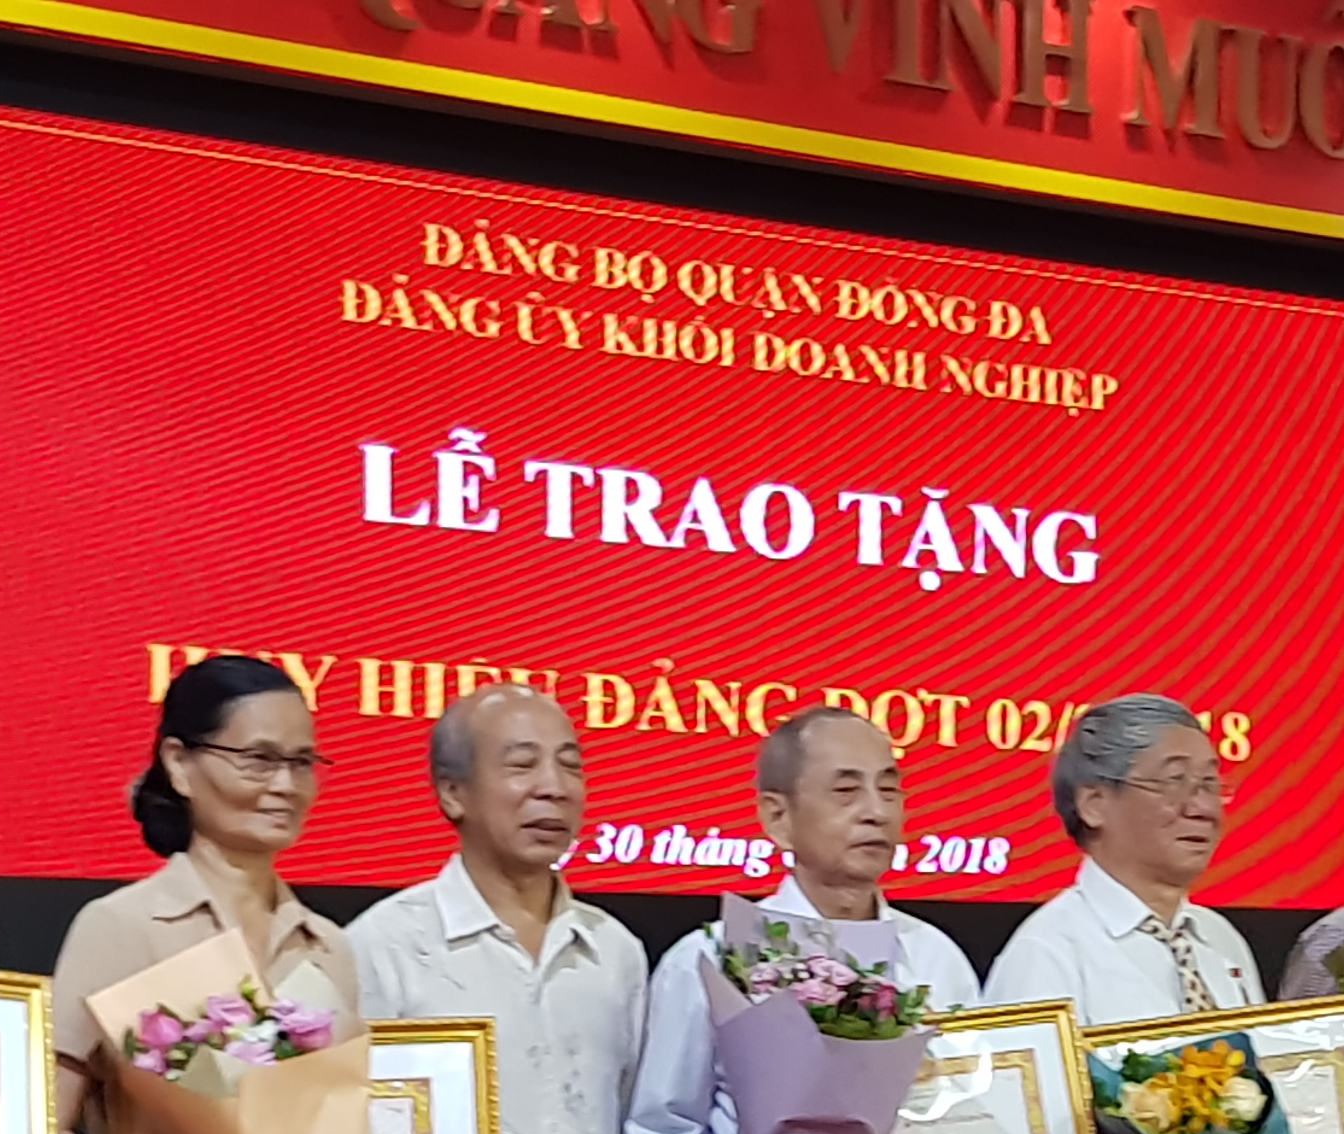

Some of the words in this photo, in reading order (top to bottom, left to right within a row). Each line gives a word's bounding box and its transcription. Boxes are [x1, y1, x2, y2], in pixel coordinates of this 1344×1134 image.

[339, 273, 505, 338] ĐẢNG
[752, 331, 928, 391] DOANH
[420, 218, 582, 284] ĐẢNG
[986, 300, 1052, 345] ĐA
[359, 427, 501, 532] LỄ
[524, 460, 815, 560] TRAO
[838, 487, 1099, 591] TẶNG
[586, 823, 644, 863] 30
[651, 824, 775, 878] tháng
[915, 834, 1011, 875] 2018
